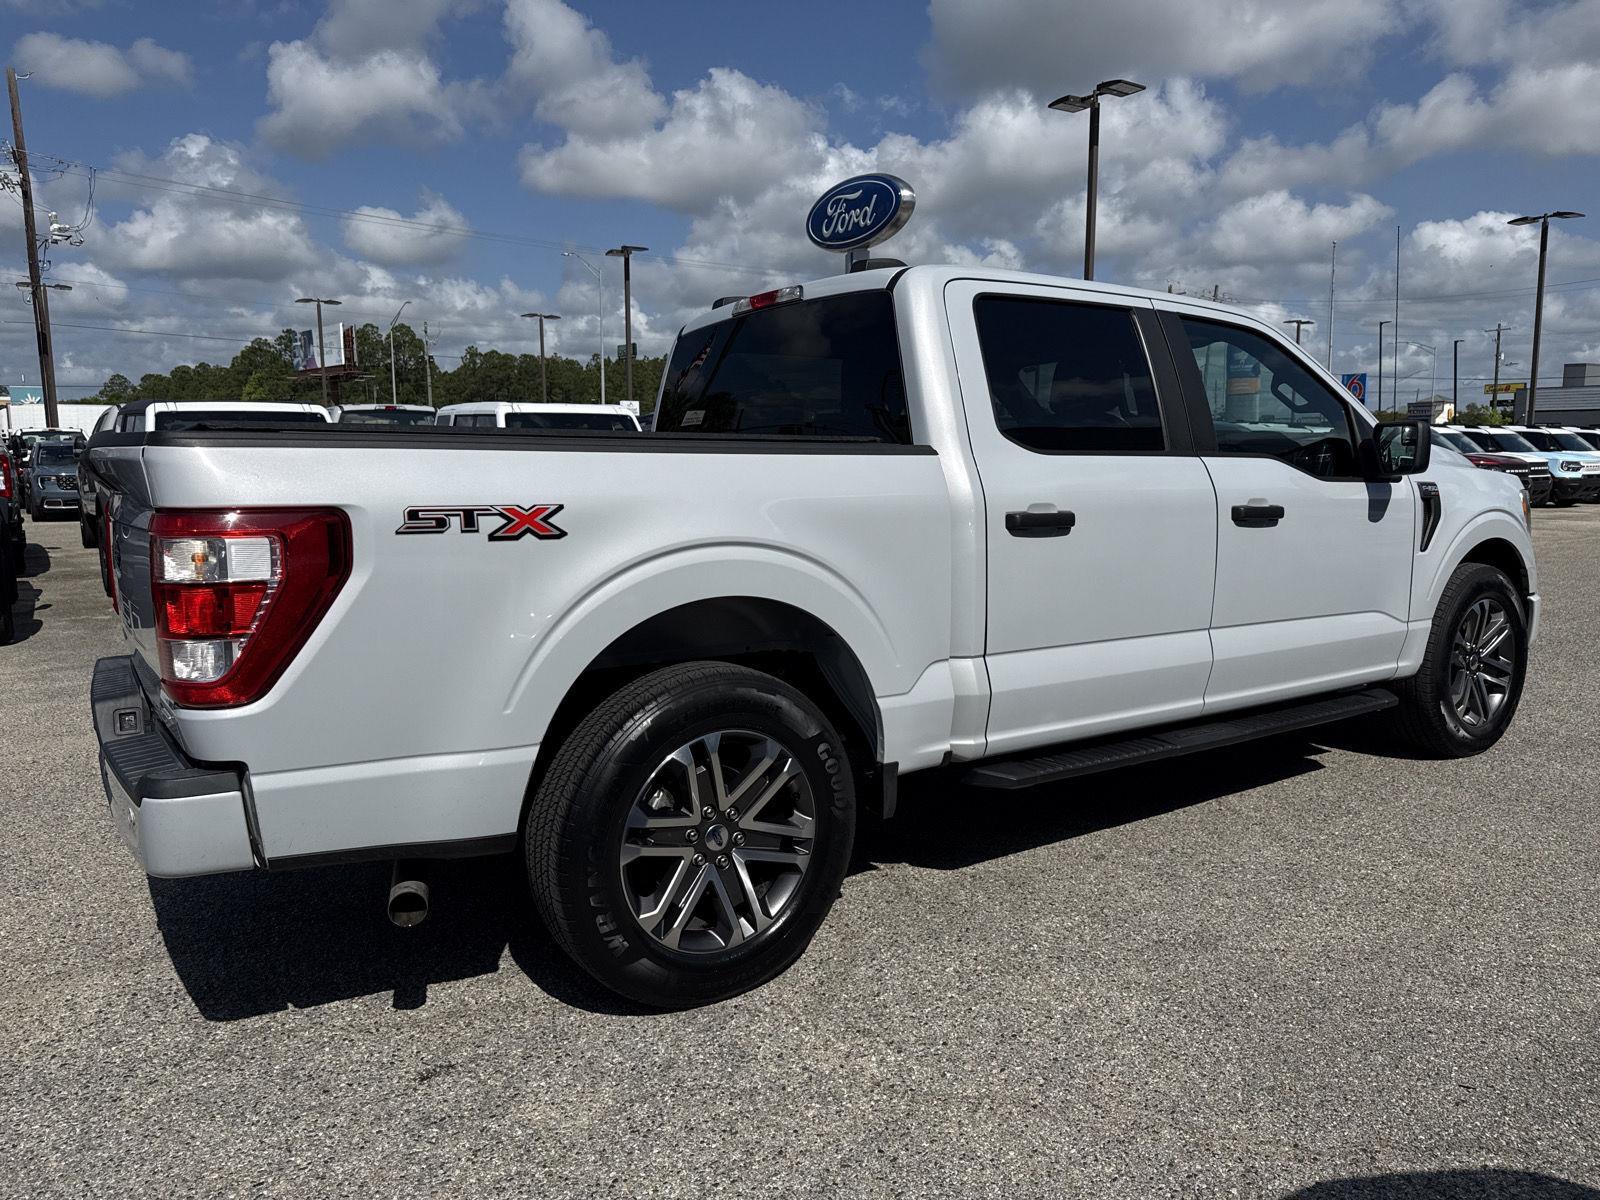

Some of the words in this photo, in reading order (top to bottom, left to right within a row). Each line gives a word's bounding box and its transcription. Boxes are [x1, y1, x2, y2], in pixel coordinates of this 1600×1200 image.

[822, 189, 877, 238] Ford
[1347, 374, 1364, 398] 6
[395, 504, 568, 541] STX
